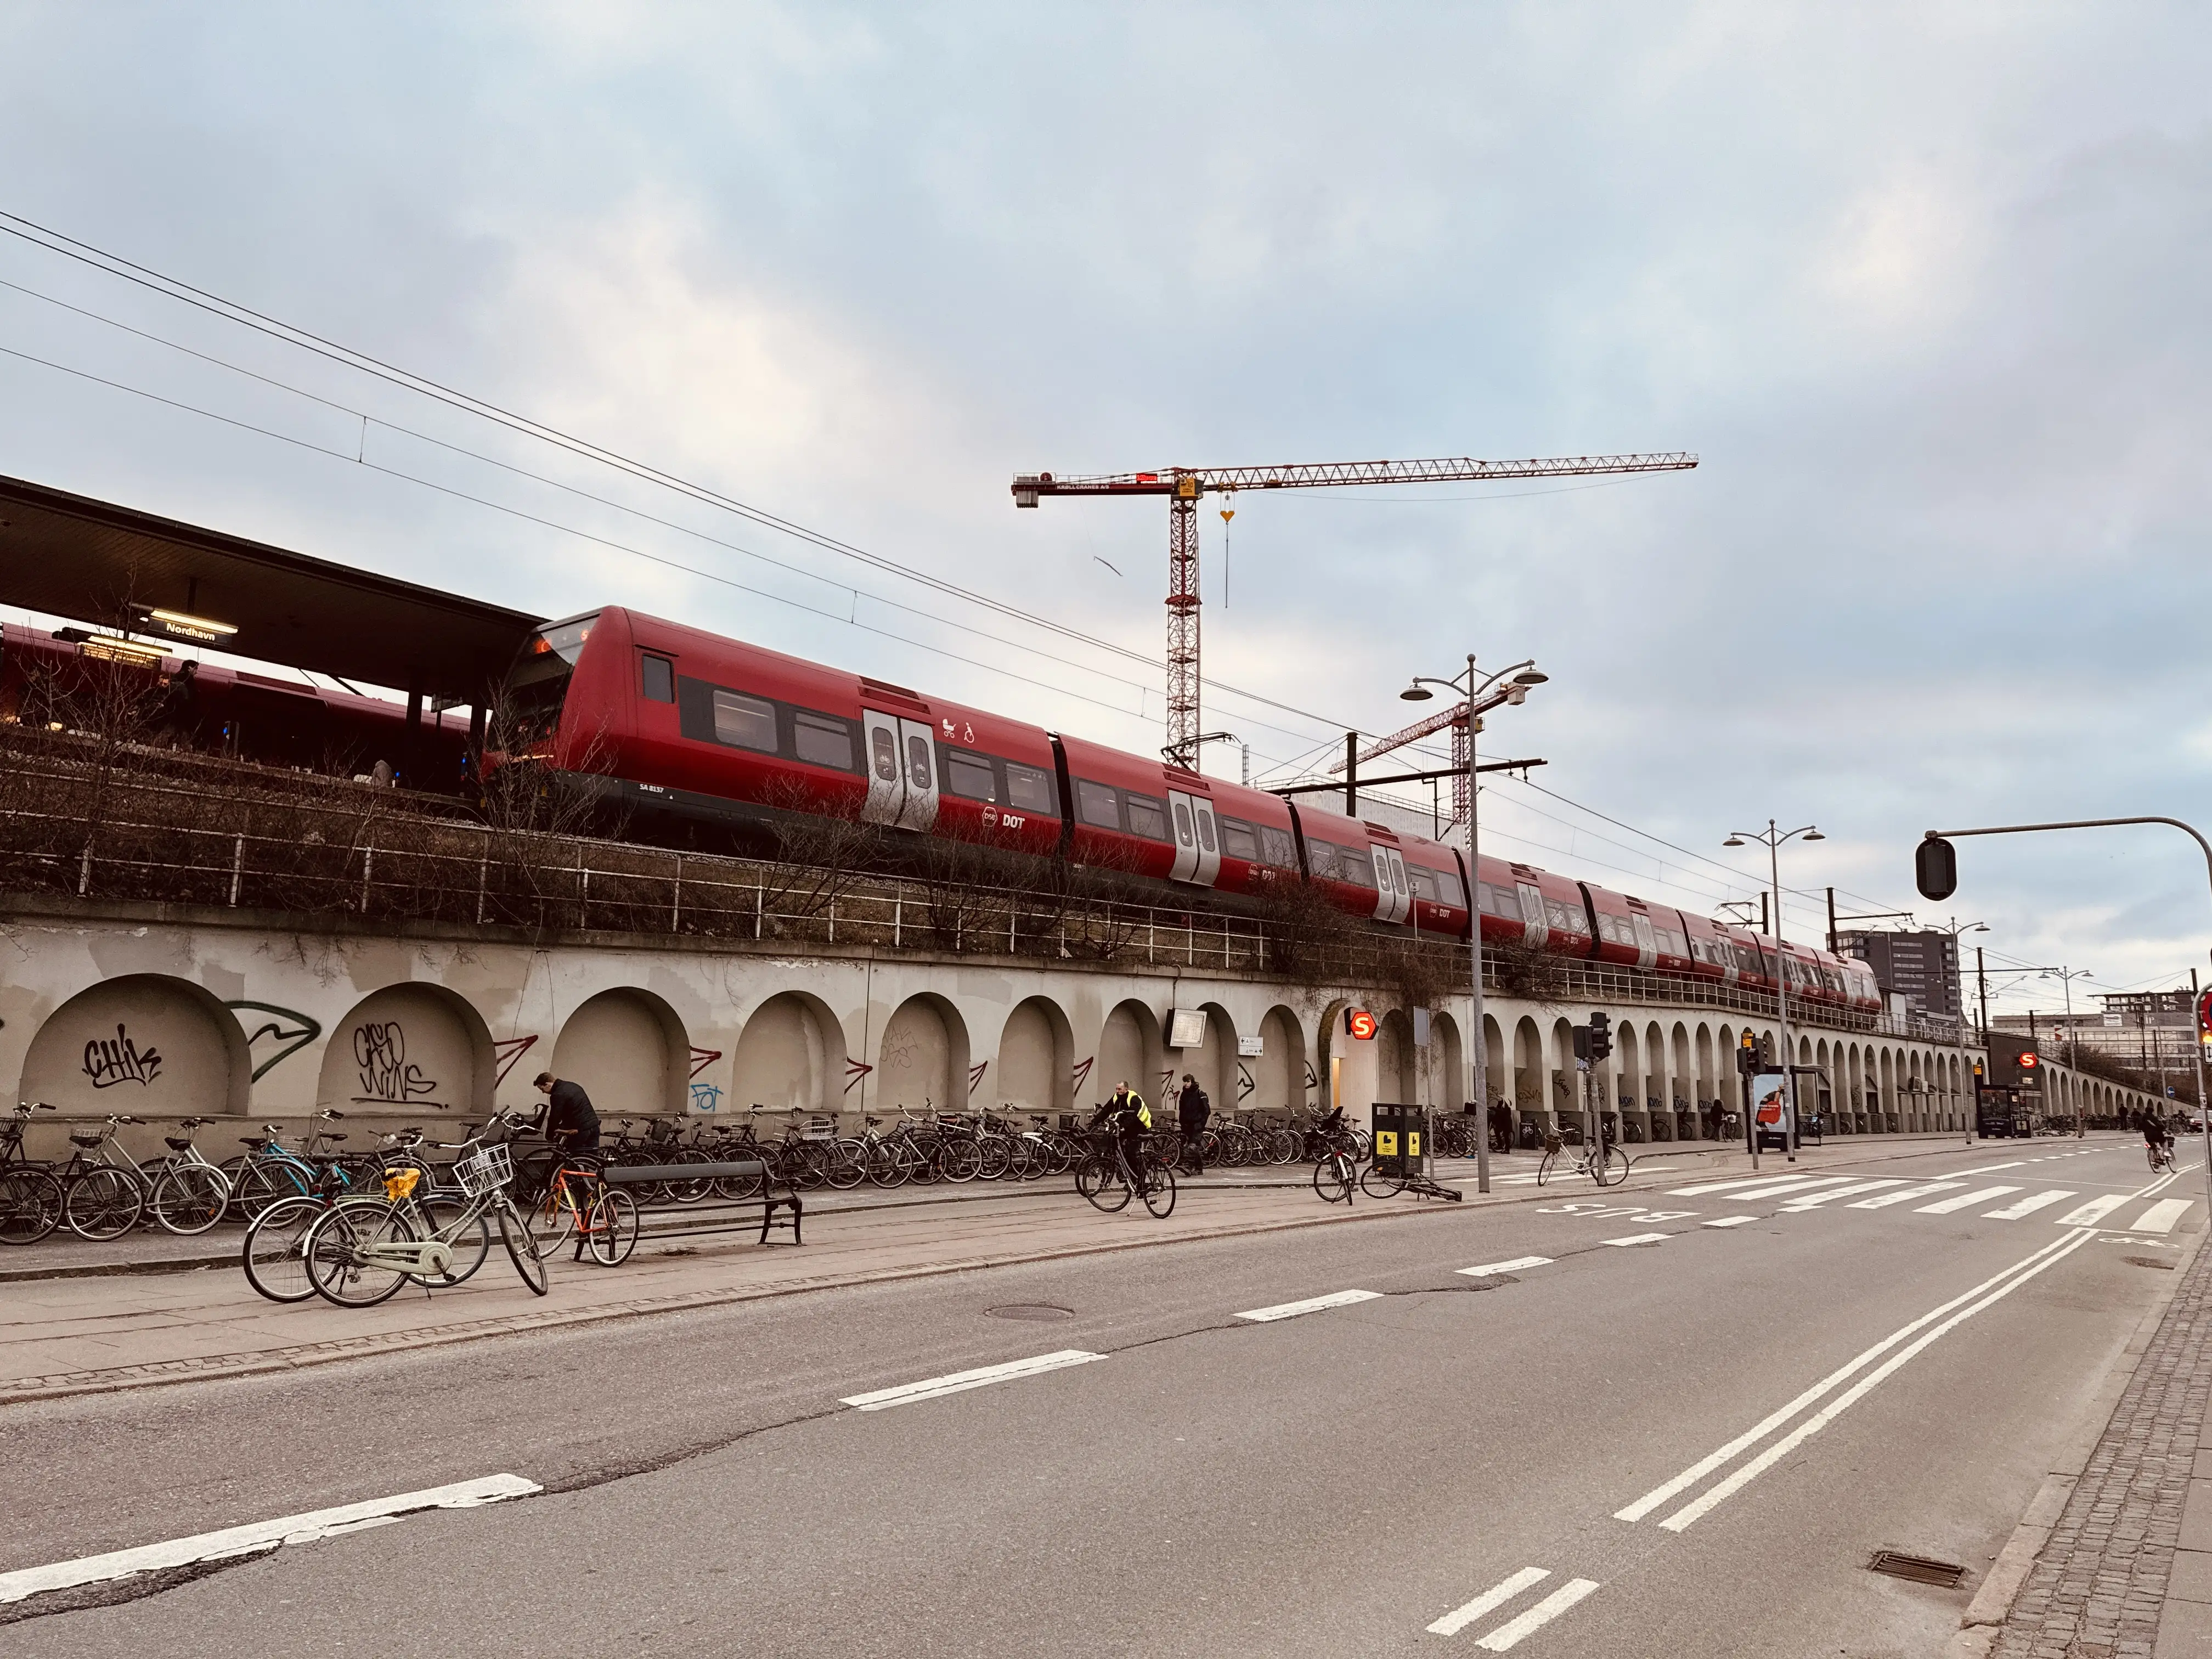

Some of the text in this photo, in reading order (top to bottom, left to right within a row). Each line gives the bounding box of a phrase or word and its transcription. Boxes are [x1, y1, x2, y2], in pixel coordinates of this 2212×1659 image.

[166, 623, 216, 641] Nordhavn
[1002, 814, 1025, 829] DOT
[1355, 1017, 1369, 1035] S
[2022, 1054, 2034, 1066] S
[1536, 1204, 1702, 1223] BUS
